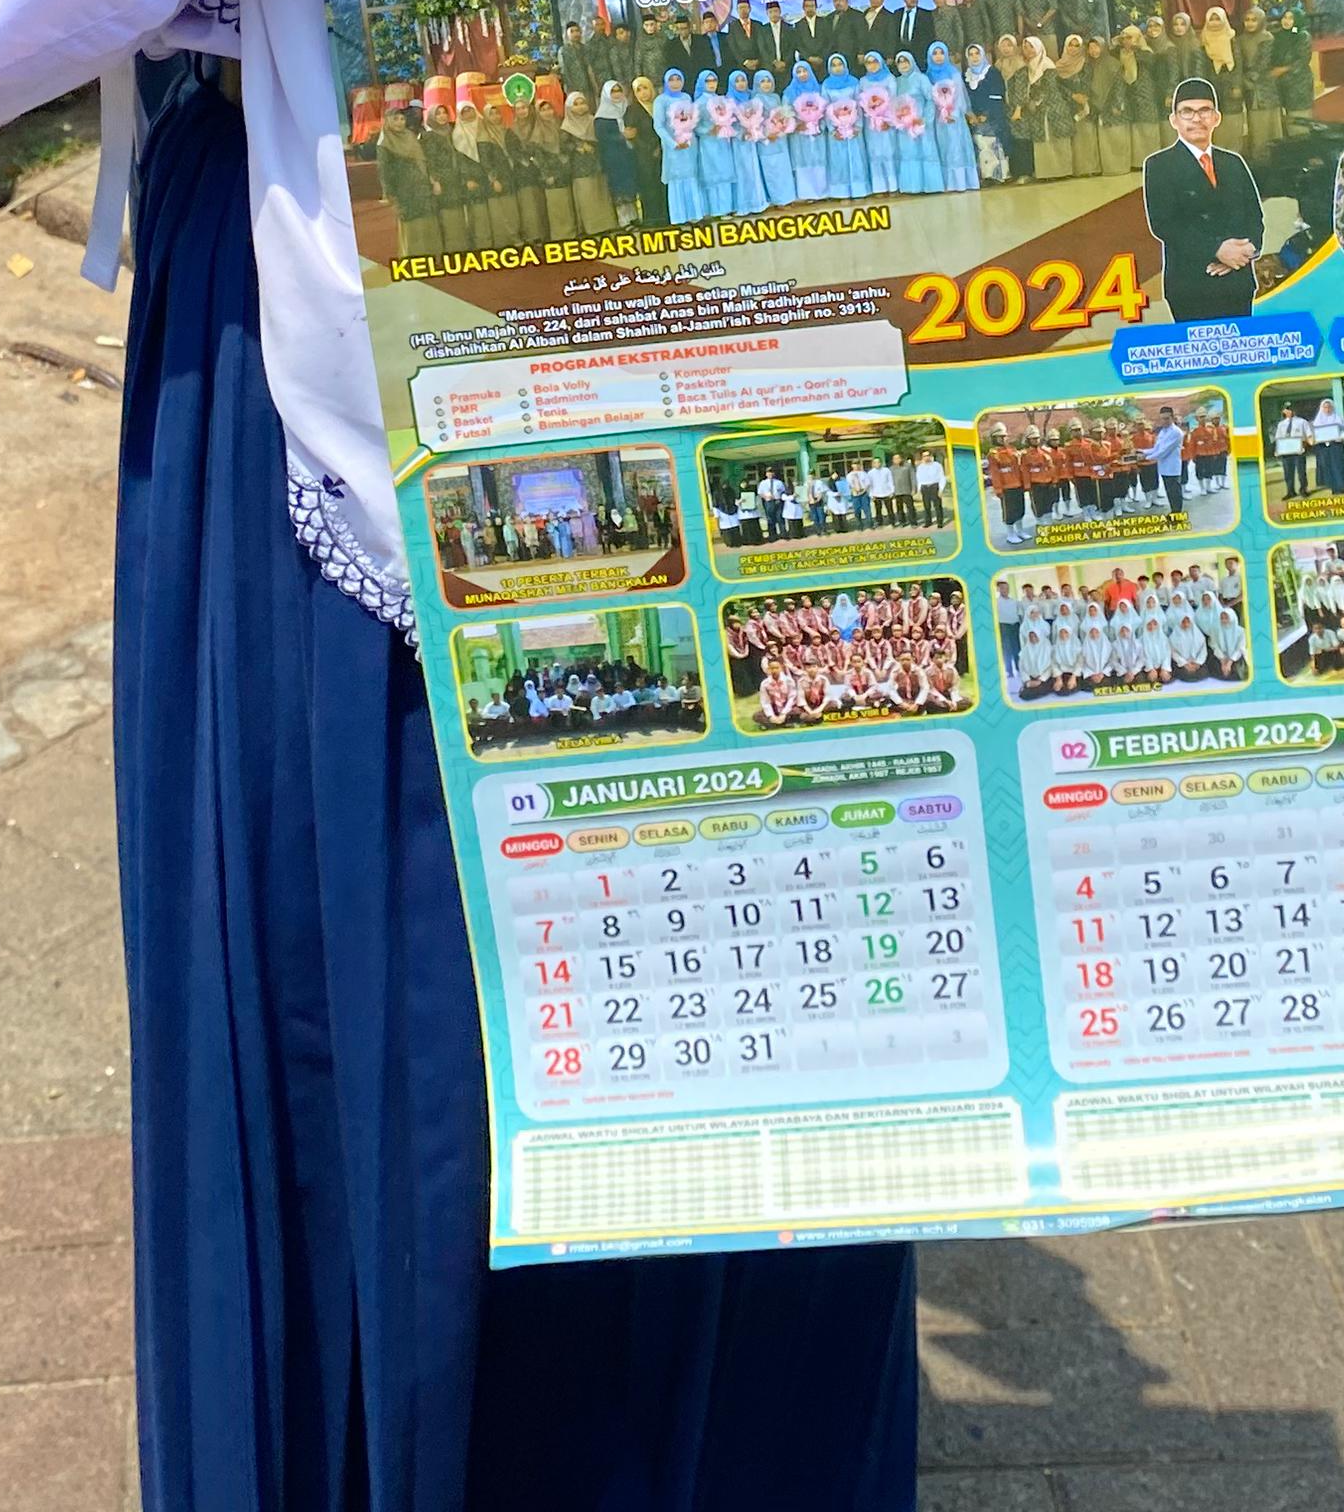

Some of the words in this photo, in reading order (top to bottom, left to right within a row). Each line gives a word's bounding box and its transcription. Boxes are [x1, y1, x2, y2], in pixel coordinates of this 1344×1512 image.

[391, 249, 539, 281] KELUARGA
[545, 236, 636, 265] BESAR
[641, 227, 713, 256] MTsN
[719, 207, 891, 246] BANGKALAN
[625, 294, 662, 311] wajib
[664, 292, 693, 305] atas
[696, 288, 738, 303] setiap
[906, 252, 1148, 345] 2024
[425, 339, 506, 360] dishahihkan
[509, 338, 524, 351] Al
[526, 334, 569, 349] Albani
[572, 330, 613, 345] dalam
[814, 307, 836, 319] no.
[476, 324, 516, 341] Majah
[519, 322, 540, 335] no.
[574, 316, 601, 330] dari
[604, 310, 657, 326] sahabat
[659, 307, 695, 320] Anas
[698, 303, 720, 316] bin
[723, 299, 759, 314] Malik
[1188, 325, 1238, 339] KEPALA
[530, 354, 614, 375] PROGRAM
[618, 338, 780, 365] EKSTRAKURIKULER
[1124, 363, 1148, 375] Drs.
[1151, 361, 1162, 372] H.
[1166, 355, 1219, 370] AKHMAD
[1280, 348, 1294, 359] M.
[1296, 346, 1313, 358] Pd
[1130, 341, 1218, 359] KANKEMENAG
[1222, 333, 1300, 350] BANGKALAN
[1061, 742, 1088, 759] 02
[1109, 727, 1245, 759] FEBRUARI
[1253, 720, 1322, 747] 2024
[512, 794, 535, 812] 01
[562, 775, 686, 808] JANUARI
[693, 769, 763, 794] 2024
[1048, 789, 1103, 805] MINGGU
[1124, 785, 1164, 798] SENIN
[1186, 780, 1237, 794] SELASA
[1261, 774, 1298, 787] RABU
[505, 837, 559, 854] MINGGU
[579, 833, 618, 846] SENIN
[640, 826, 689, 841] SELASA
[712, 819, 748, 833] RABU
[775, 814, 817, 826] KAMIS
[840, 807, 886, 823] JUMAT
[908, 803, 952, 817] SABTU
[598, 875, 611, 897] 1
[661, 869, 681, 892] 2
[728, 863, 746, 886] 3
[794, 857, 813, 880] 4
[861, 851, 879, 875] 5
[926, 845, 945, 869] 6
[1076, 876, 1094, 899] 4
[1144, 871, 1162, 895] 5
[1210, 865, 1229, 890] 6
[1277, 860, 1296, 885] 7
[535, 921, 553, 943] 7
[602, 915, 621, 938] 8
[667, 909, 685, 932] 9
[724, 903, 761, 928] 10
[790, 897, 823, 922] 11
[857, 892, 893, 917] 12
[923, 887, 959, 911] 13
[1075, 918, 1104, 943] 11
[1139, 913, 1177, 939] 12
[1206, 908, 1243, 934] 13
[1274, 903, 1311, 928] 14
[537, 960, 570, 984] 14
[600, 954, 636, 980] 15
[665, 949, 701, 975] 16
[730, 944, 765, 970] 17
[796, 939, 832, 964] 18
[864, 934, 898, 959] 19
[926, 929, 964, 955] 20
[1080, 963, 1113, 987] 18
[1143, 957, 1179, 984] 19
[1209, 952, 1247, 979] 20
[1276, 947, 1310, 975] 21
[543, 1004, 573, 1028] 21
[604, 997, 642, 1024] 22
[669, 992, 706, 1019] 23
[734, 988, 772, 1014] 24
[800, 982, 837, 1009] 25
[865, 977, 904, 1005] 26
[931, 972, 968, 999] 27
[1083, 1009, 1118, 1036] 25
[1147, 1003, 1185, 1032] 26
[1214, 998, 1250, 1027] 27
[1281, 994, 1320, 1022] 28
[547, 1048, 580, 1075] 28
[609, 1043, 646, 1071] 29
[674, 1038, 711, 1066] 30
[740, 1033, 772, 1061] 31
